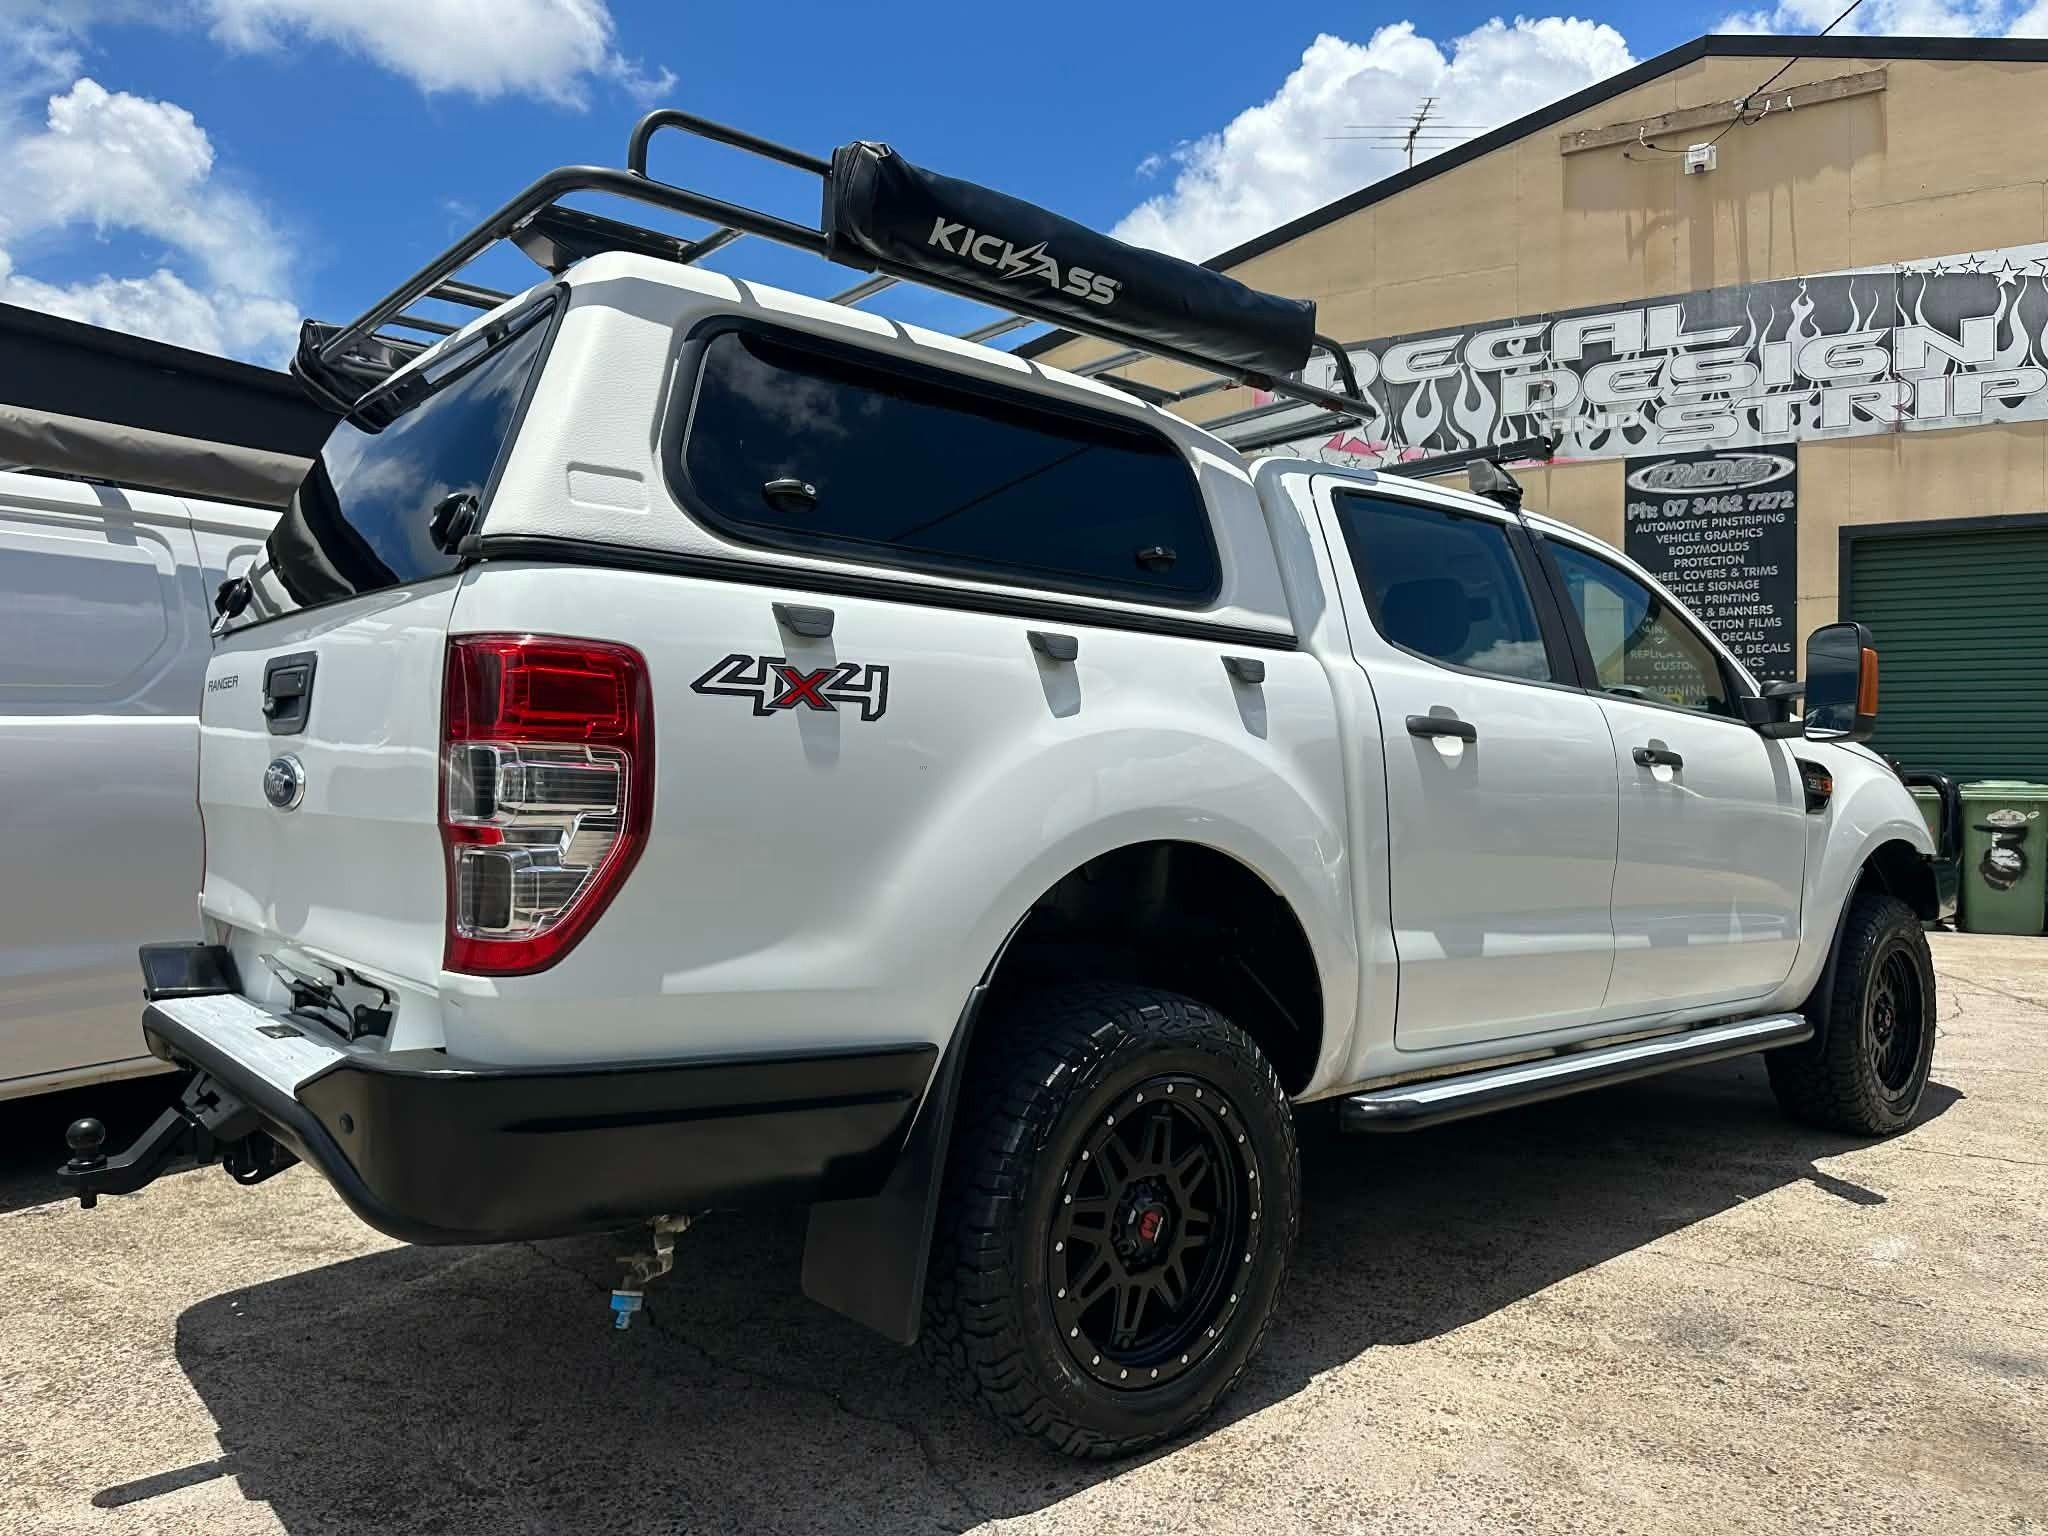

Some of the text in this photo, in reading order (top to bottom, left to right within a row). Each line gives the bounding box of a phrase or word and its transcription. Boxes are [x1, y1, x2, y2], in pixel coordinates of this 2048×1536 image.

[928, 217, 1118, 305] KICKASS
[1302, 303, 1743, 394] DECAL
[1501, 315, 1998, 417] DESIGN
[1627, 491, 1795, 520] Ph: 07 3462 7272
[1635, 513, 1785, 533] AUTOMOTIVE PINSTRIPING
[1656, 527, 1764, 545] VEHICLE GRAPHICS
[1668, 541, 1750, 556] BODYMOULDS
[1674, 554, 1745, 569] PROTECTION
[1683, 568, 1727, 581] COVERS
[1730, 567, 1740, 578] &
[1742, 565, 1778, 577] TRIMS
[1664, 579, 1760, 593] EHICLE SIGNAGE
[1704, 592, 1761, 605] PRINTING
[1706, 607, 1715, 618] &
[1718, 604, 1774, 617] BANNERS
[1749, 616, 1782, 628] FILMS
[1721, 630, 1765, 642] DECALS
[1734, 645, 1743, 655] &
[1746, 642, 1791, 654] DECALS
[208, 675, 239, 692] RANGER
